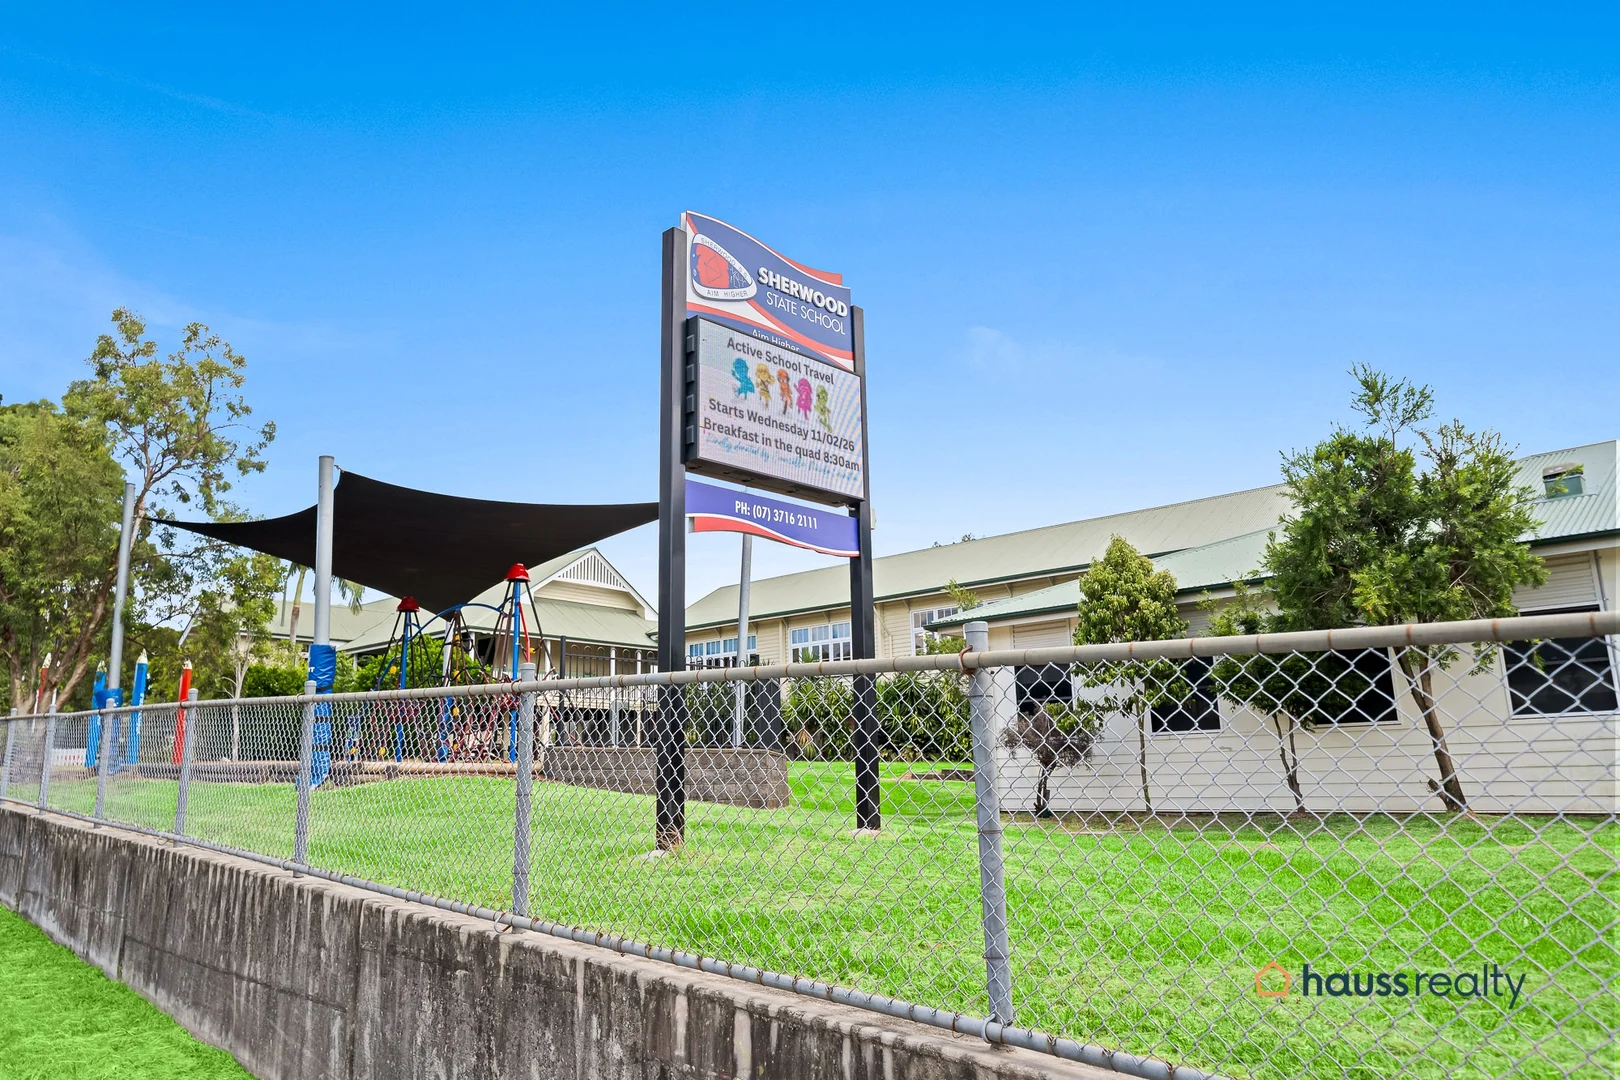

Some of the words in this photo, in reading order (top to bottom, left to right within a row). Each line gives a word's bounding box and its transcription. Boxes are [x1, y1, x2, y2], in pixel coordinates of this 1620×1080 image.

[700, 237, 736, 266] SHERWOOD
[723, 290, 748, 298] HIGHER
[758, 267, 848, 317] SHERWOOD
[766, 291, 798, 316] STATE
[800, 305, 846, 335] SCHOOL
[752, 329, 770, 341] Aim
[727, 337, 763, 360] Active
[765, 351, 802, 374] School
[803, 363, 835, 385] Travel
[703, 417, 759, 443] Breakfast
[761, 433, 772, 448] in
[774, 438, 793, 453] the
[795, 446, 821, 461] quad
[823, 452, 860, 472] 8:30am
[709, 398, 744, 419] Starts
[747, 409, 809, 441] Wednesday
[811, 429, 855, 452] 11/02/26
[735, 500, 751, 516] PH:
[752, 506, 771, 522] (07)
[773, 510, 795, 525] 3716
[797, 515, 818, 530] 2111
